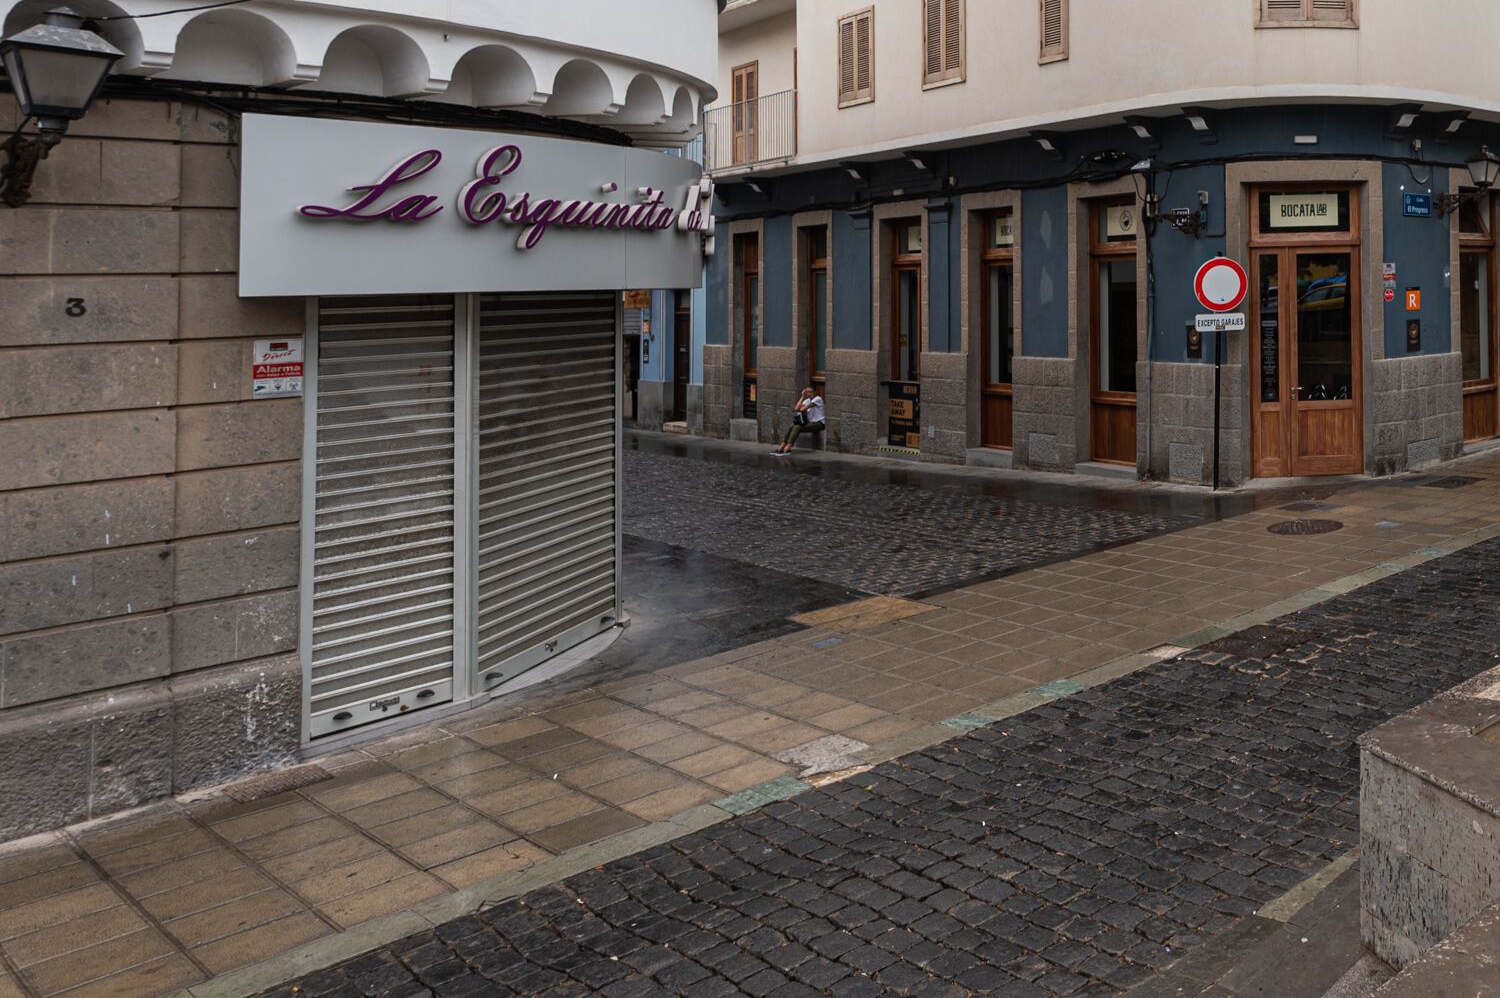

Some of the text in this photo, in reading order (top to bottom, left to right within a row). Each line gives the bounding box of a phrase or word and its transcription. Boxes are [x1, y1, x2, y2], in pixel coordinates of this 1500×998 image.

[297, 149, 444, 221] La
[457, 144, 674, 250] Esquinita
[1281, 203, 1328, 217] BOCATA LAB
[66, 298, 86, 317] 3
[1409, 293, 1417, 308] R
[1197, 317, 1244, 327] EXCEPTO GARAJES
[256, 365, 301, 374] Alarma
